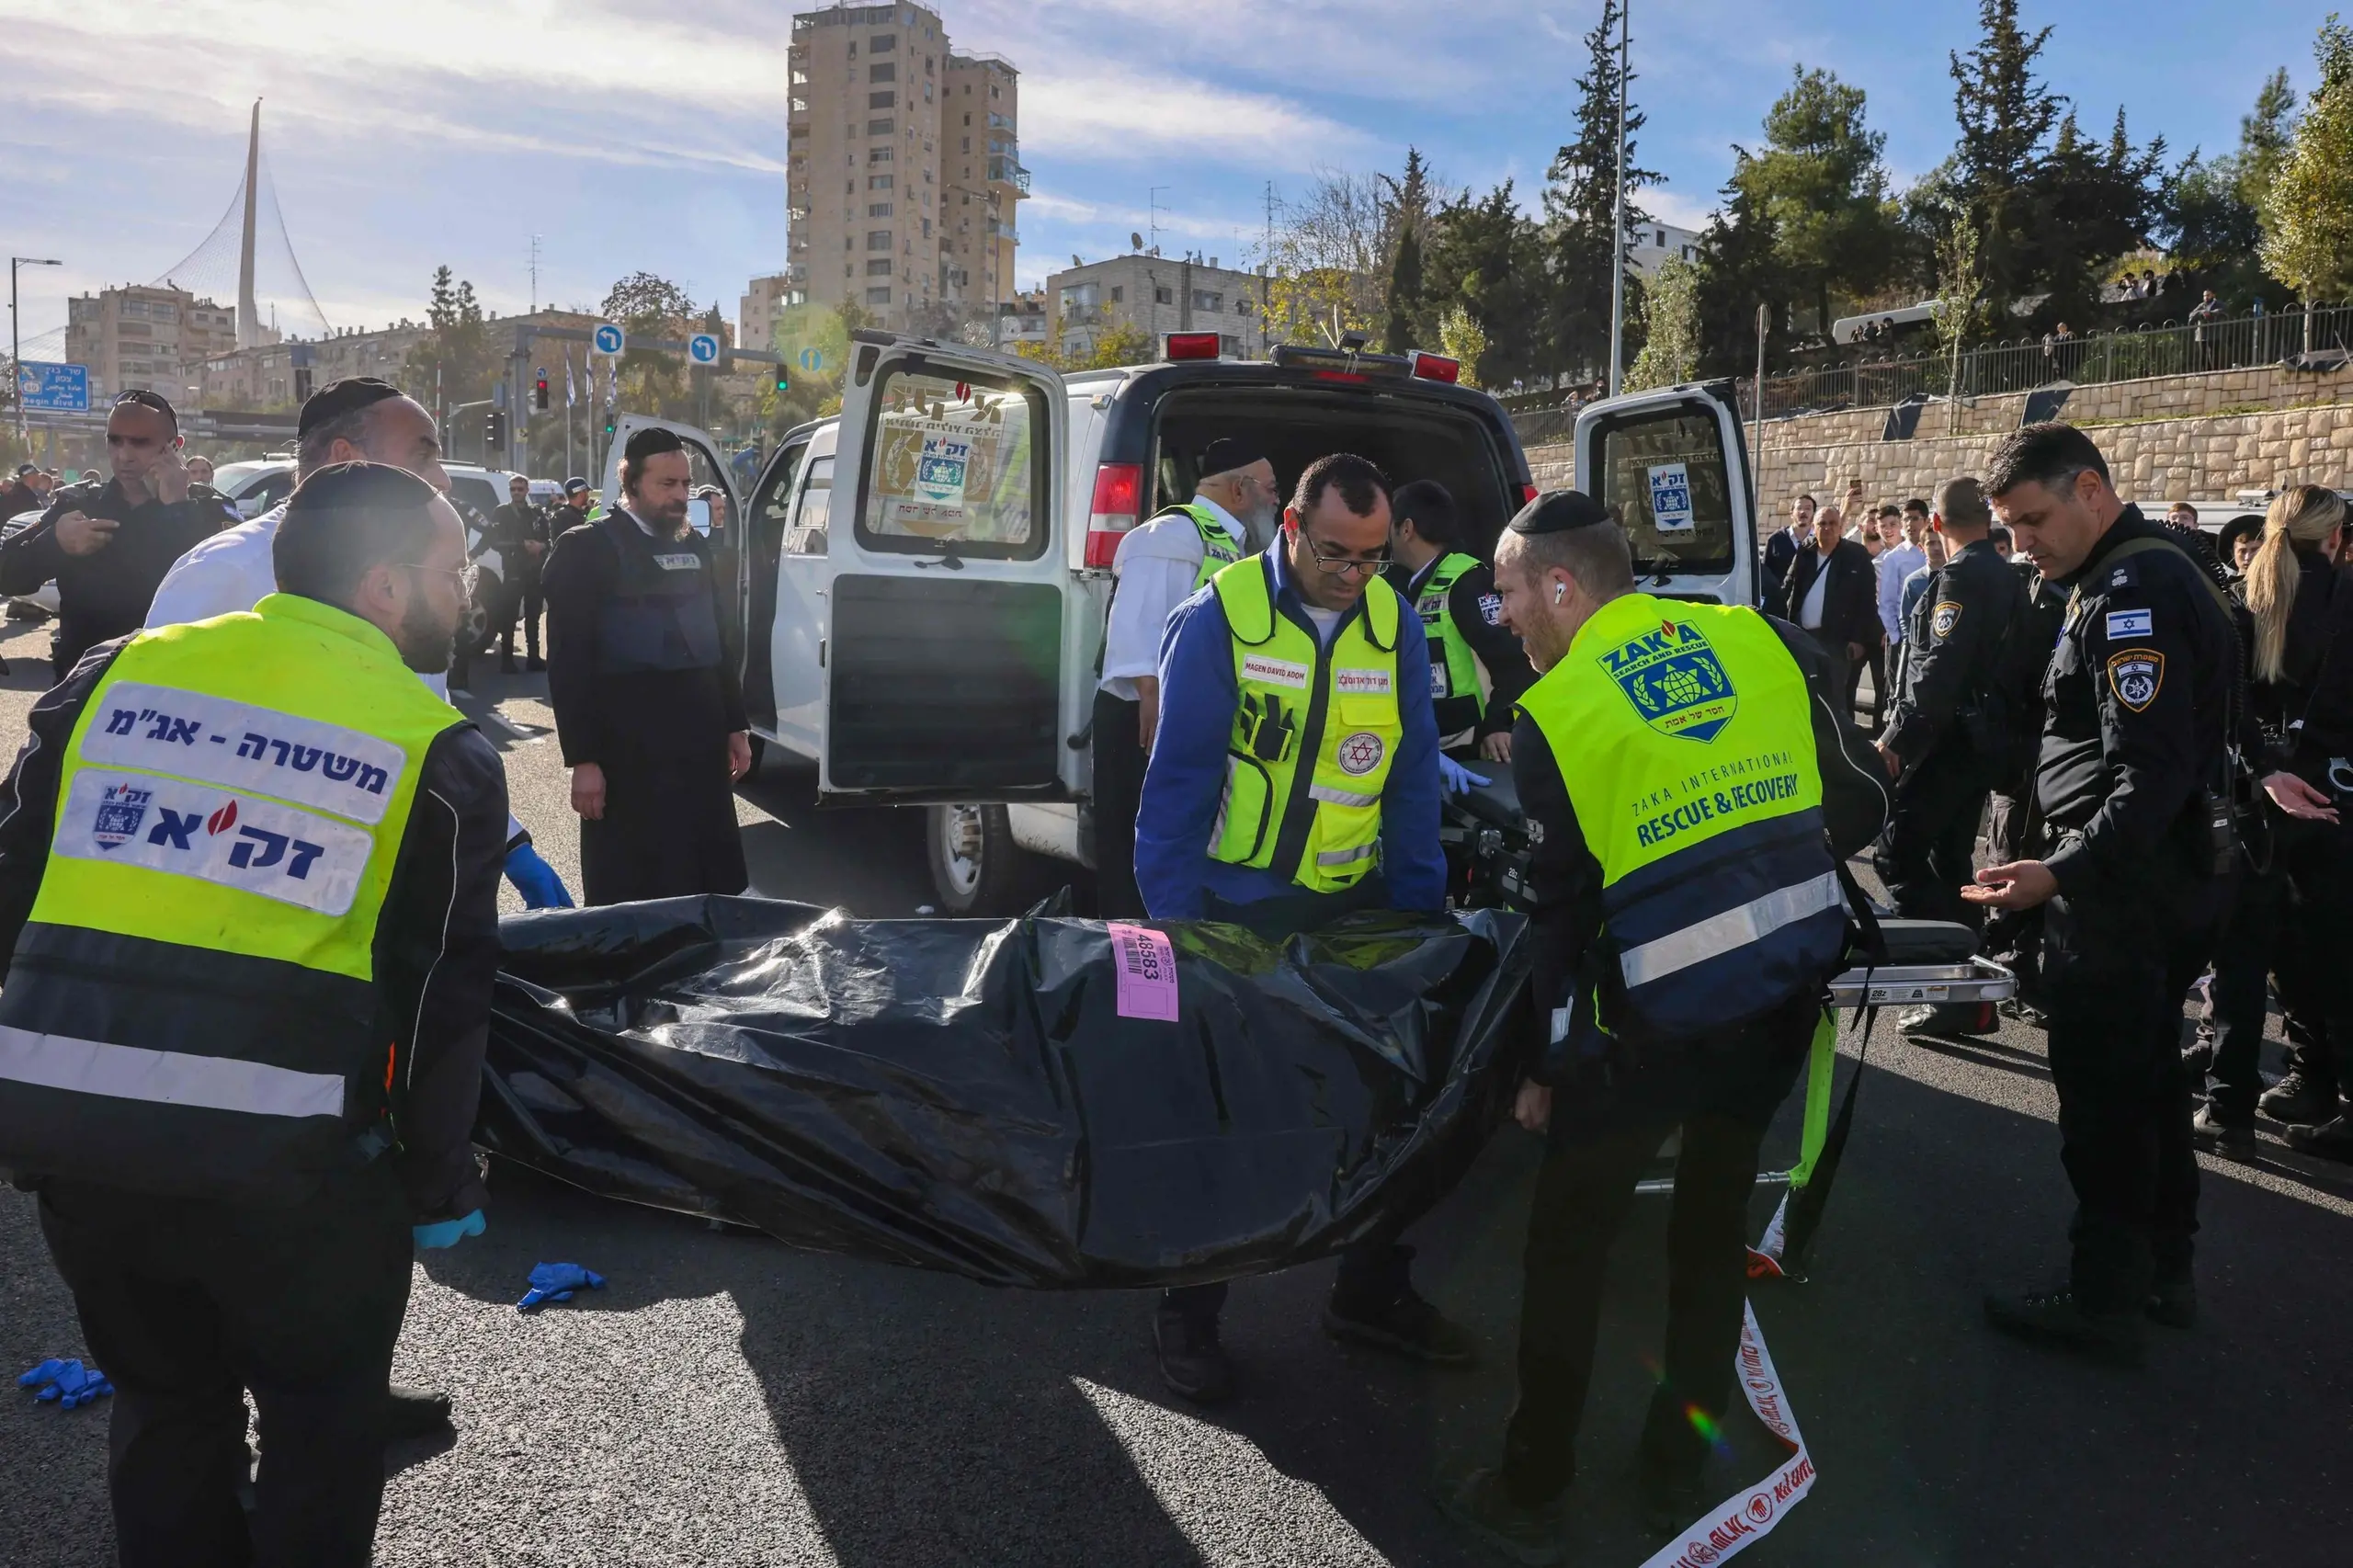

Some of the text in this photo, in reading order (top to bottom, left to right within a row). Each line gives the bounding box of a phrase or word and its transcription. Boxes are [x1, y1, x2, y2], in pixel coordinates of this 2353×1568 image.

[1245, 662, 1305, 680] MAGEN DAVID ADOM
[1613, 641, 1709, 678] SEARCH AND RESCUE
[105, 709, 201, 746] אג"מ
[1665, 706, 1724, 729] חסד של אמת
[236, 733, 388, 795] משטרה
[1631, 751, 1793, 817] ZAKA INTERNATIONAL
[1637, 797, 1715, 847] RESCUE
[1713, 792, 1733, 814] &
[1137, 934, 1159, 981] 48583
[1709, 1514, 1756, 1551] ישראל
[1773, 1472, 1793, 1504] אין
